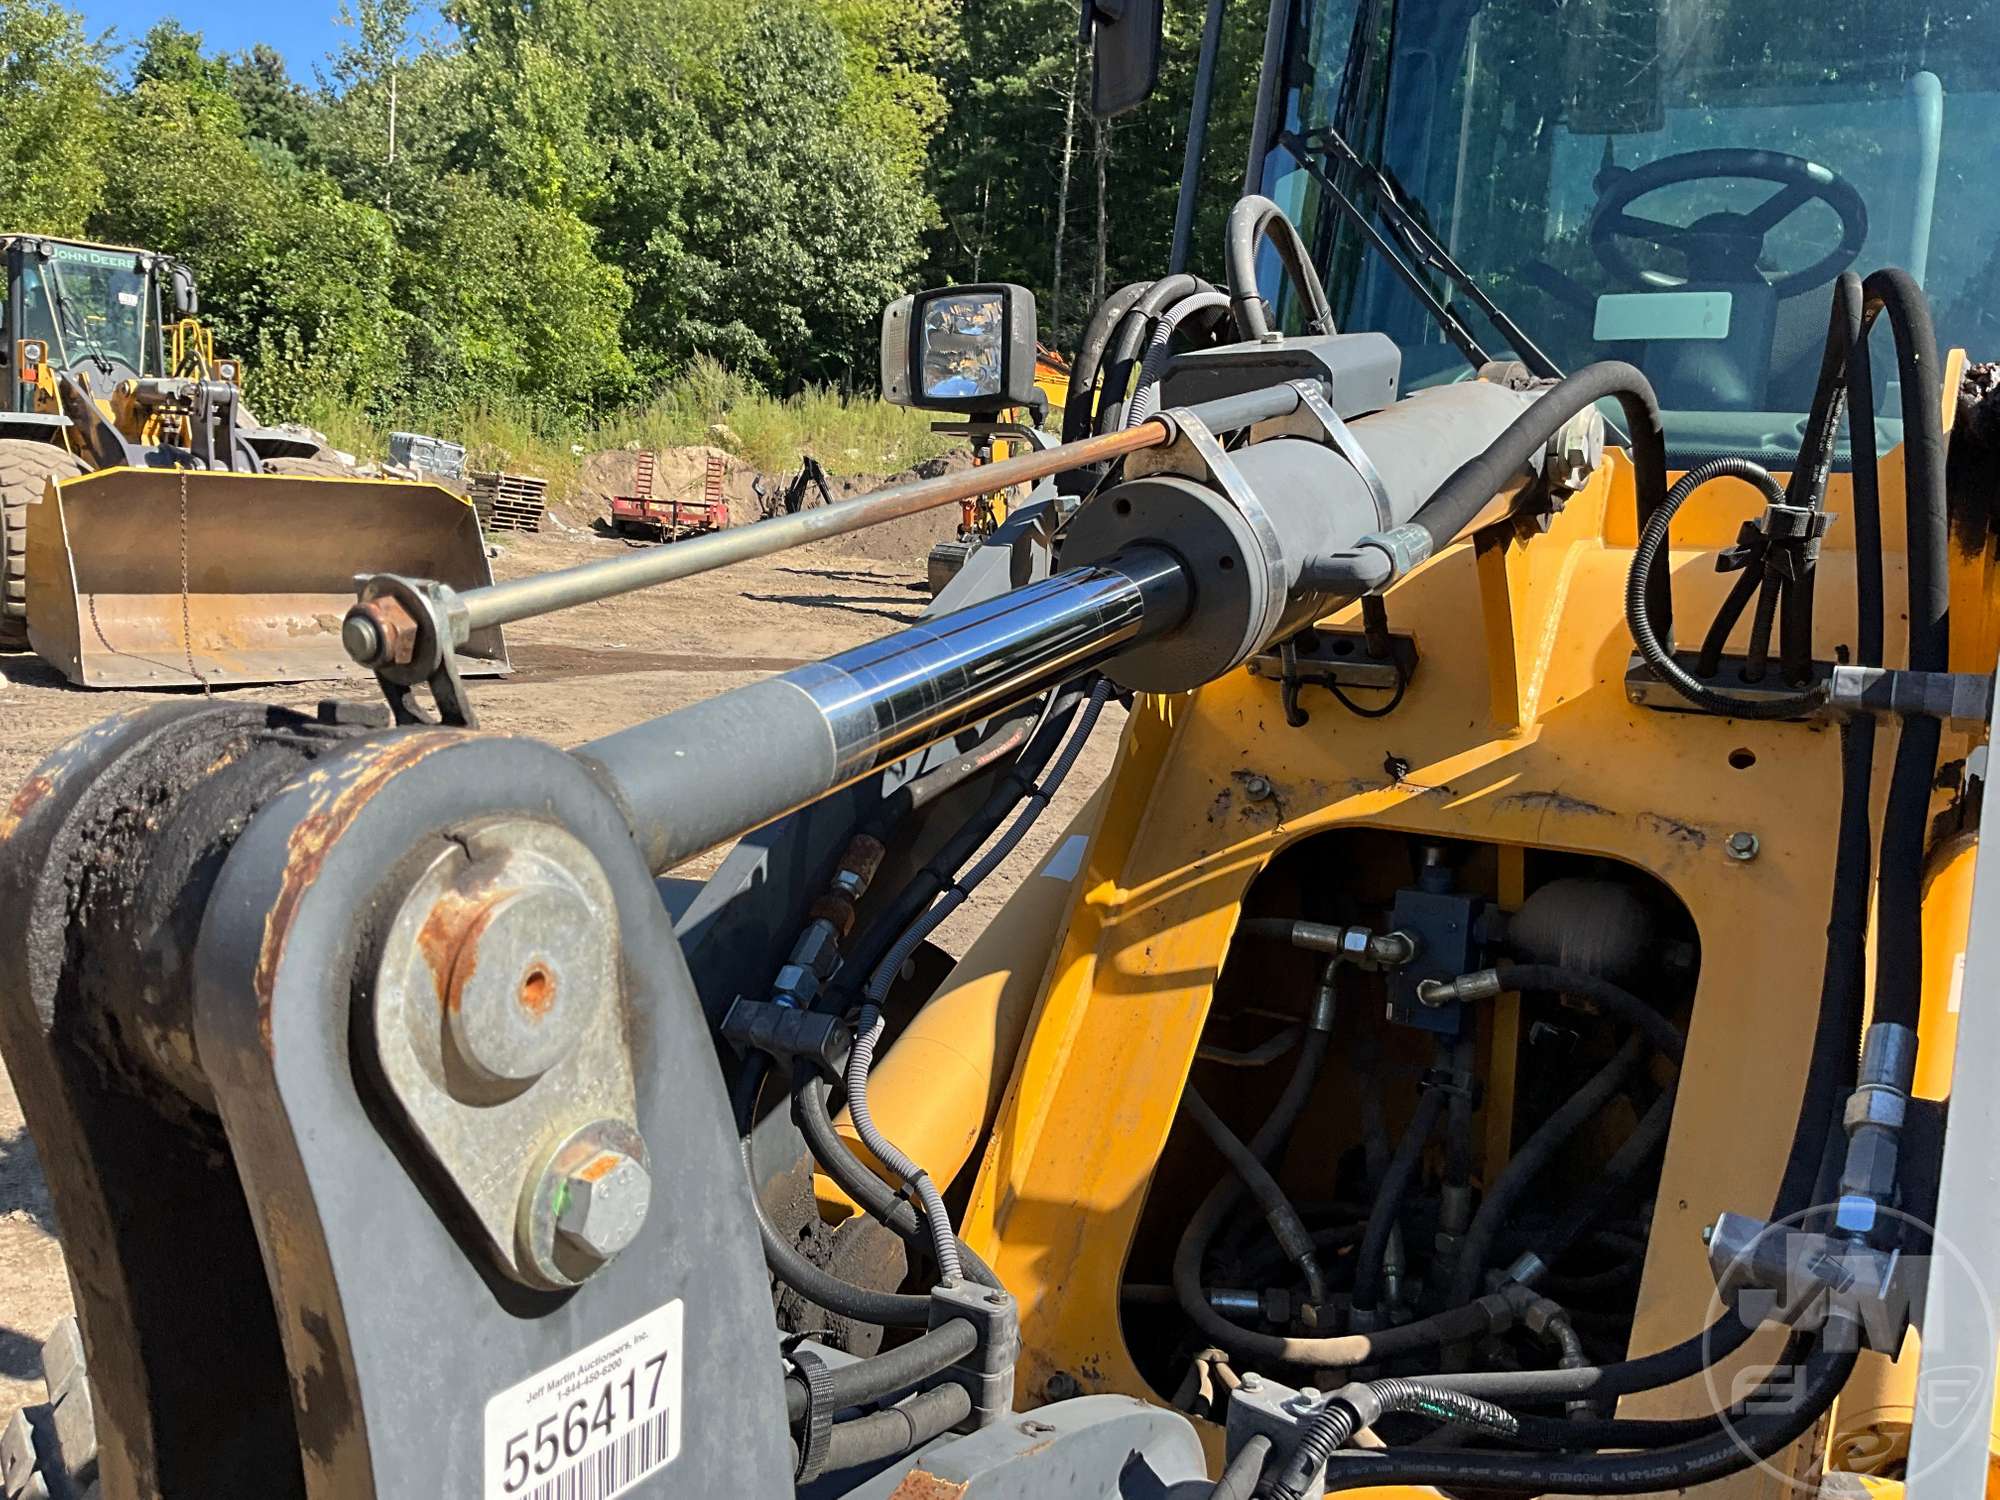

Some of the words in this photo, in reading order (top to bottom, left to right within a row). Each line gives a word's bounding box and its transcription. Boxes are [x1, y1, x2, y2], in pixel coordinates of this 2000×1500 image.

[53, 247, 87, 262] JOHN
[91, 253, 134, 268] DEERE
[526, 1385, 545, 1404] Jeff
[547, 1370, 575, 1391] Martin
[633, 1331, 648, 1345] Inc.
[503, 1350, 668, 1494] 556417
